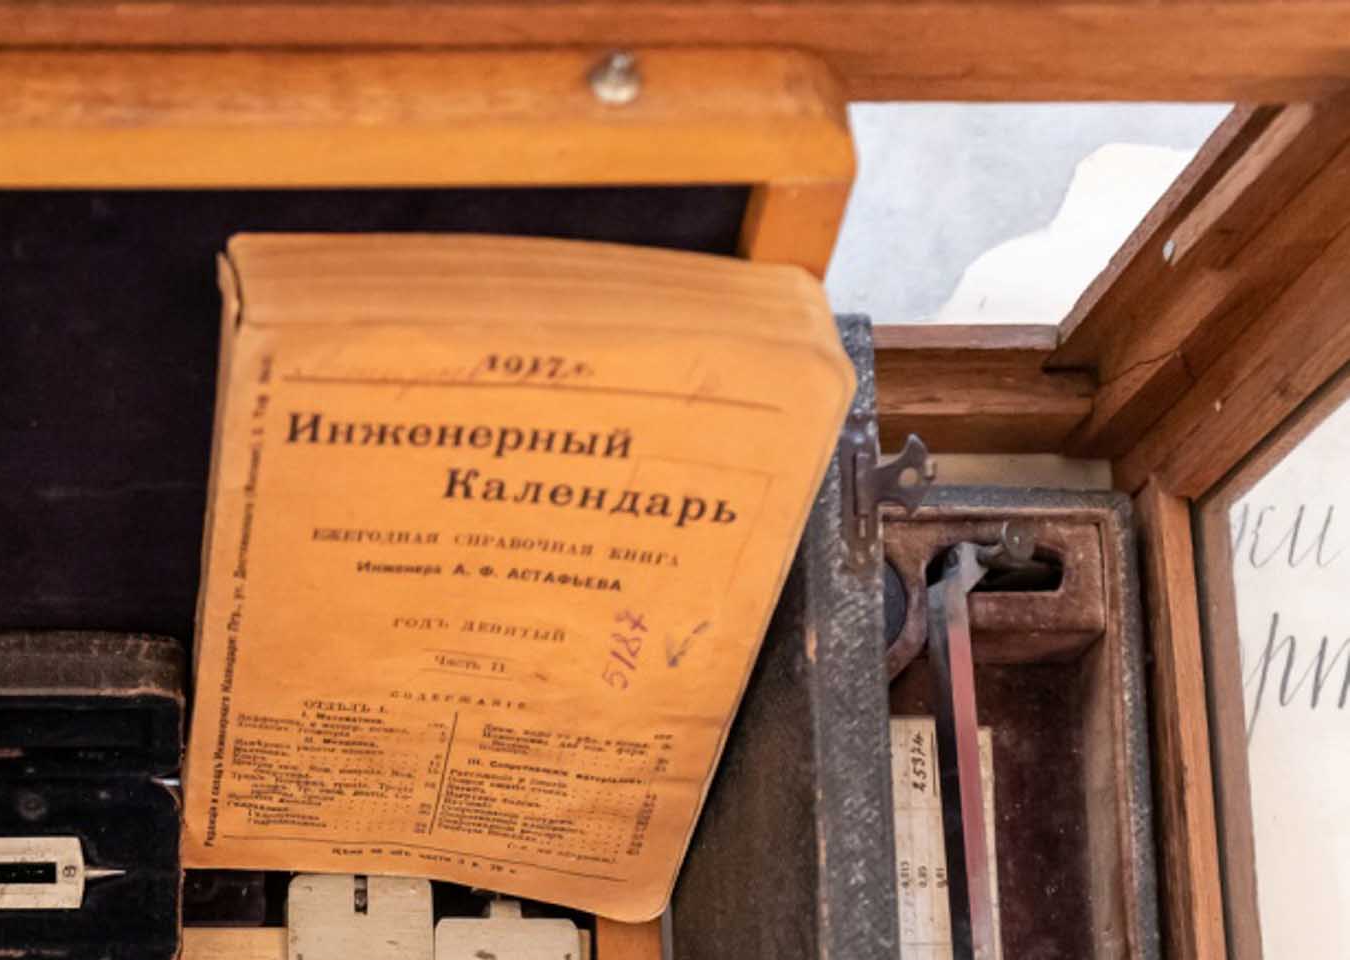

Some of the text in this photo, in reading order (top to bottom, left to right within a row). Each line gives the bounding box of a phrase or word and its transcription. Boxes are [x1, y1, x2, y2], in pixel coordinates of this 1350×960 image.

[285, 411, 633, 459] Инженерный
[443, 467, 738, 528] Календарь
[312, 527, 681, 568] ЕЖЕГОДНАЯ СПРАВОЧНАЯ КНИГА
[356, 560, 443, 577] Инженера
[506, 566, 623, 592] АСТАФЬЕВА
[460, 619, 568, 643] ДЕВЯТЫЙ
